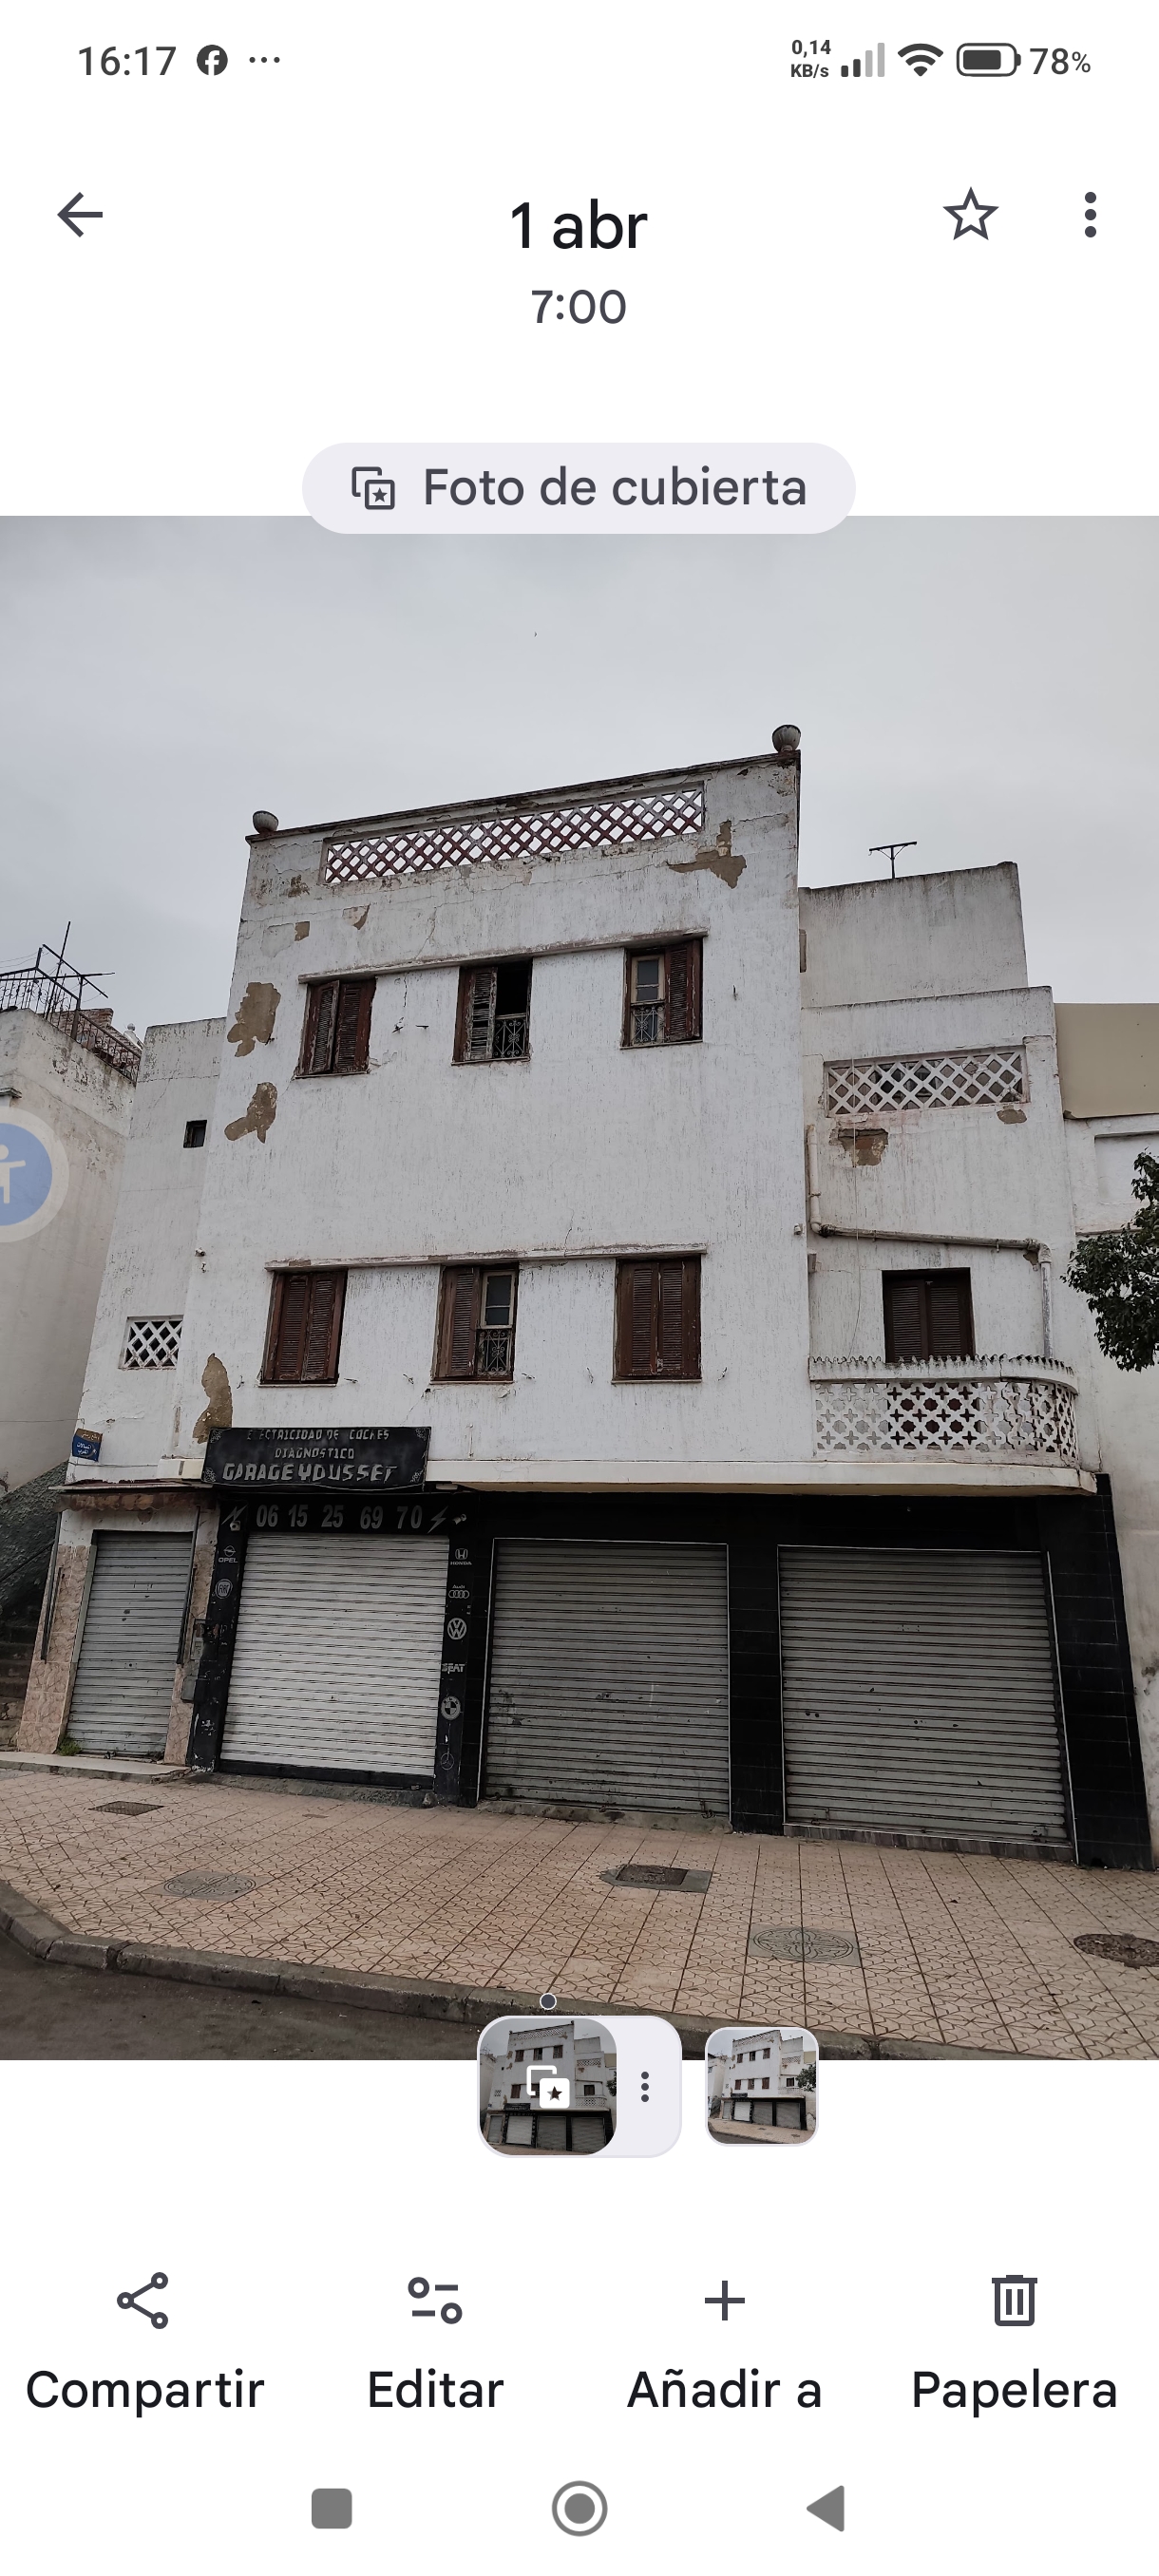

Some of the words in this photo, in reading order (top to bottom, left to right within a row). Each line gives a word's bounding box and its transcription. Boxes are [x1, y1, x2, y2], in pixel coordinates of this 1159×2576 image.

[247, 1429, 323, 1440] EECTRICIDAD
[275, 1447, 354, 1459] DIAGNOSTICO
[222, 1463, 294, 1481] GARAGE
[256, 1504, 279, 1528] 06
[288, 1504, 309, 1528] 15
[321, 1504, 344, 1528] 25
[360, 1506, 384, 1530] 69
[396, 1505, 423, 1529] 70
[441, 1662, 466, 1673] SEAT
